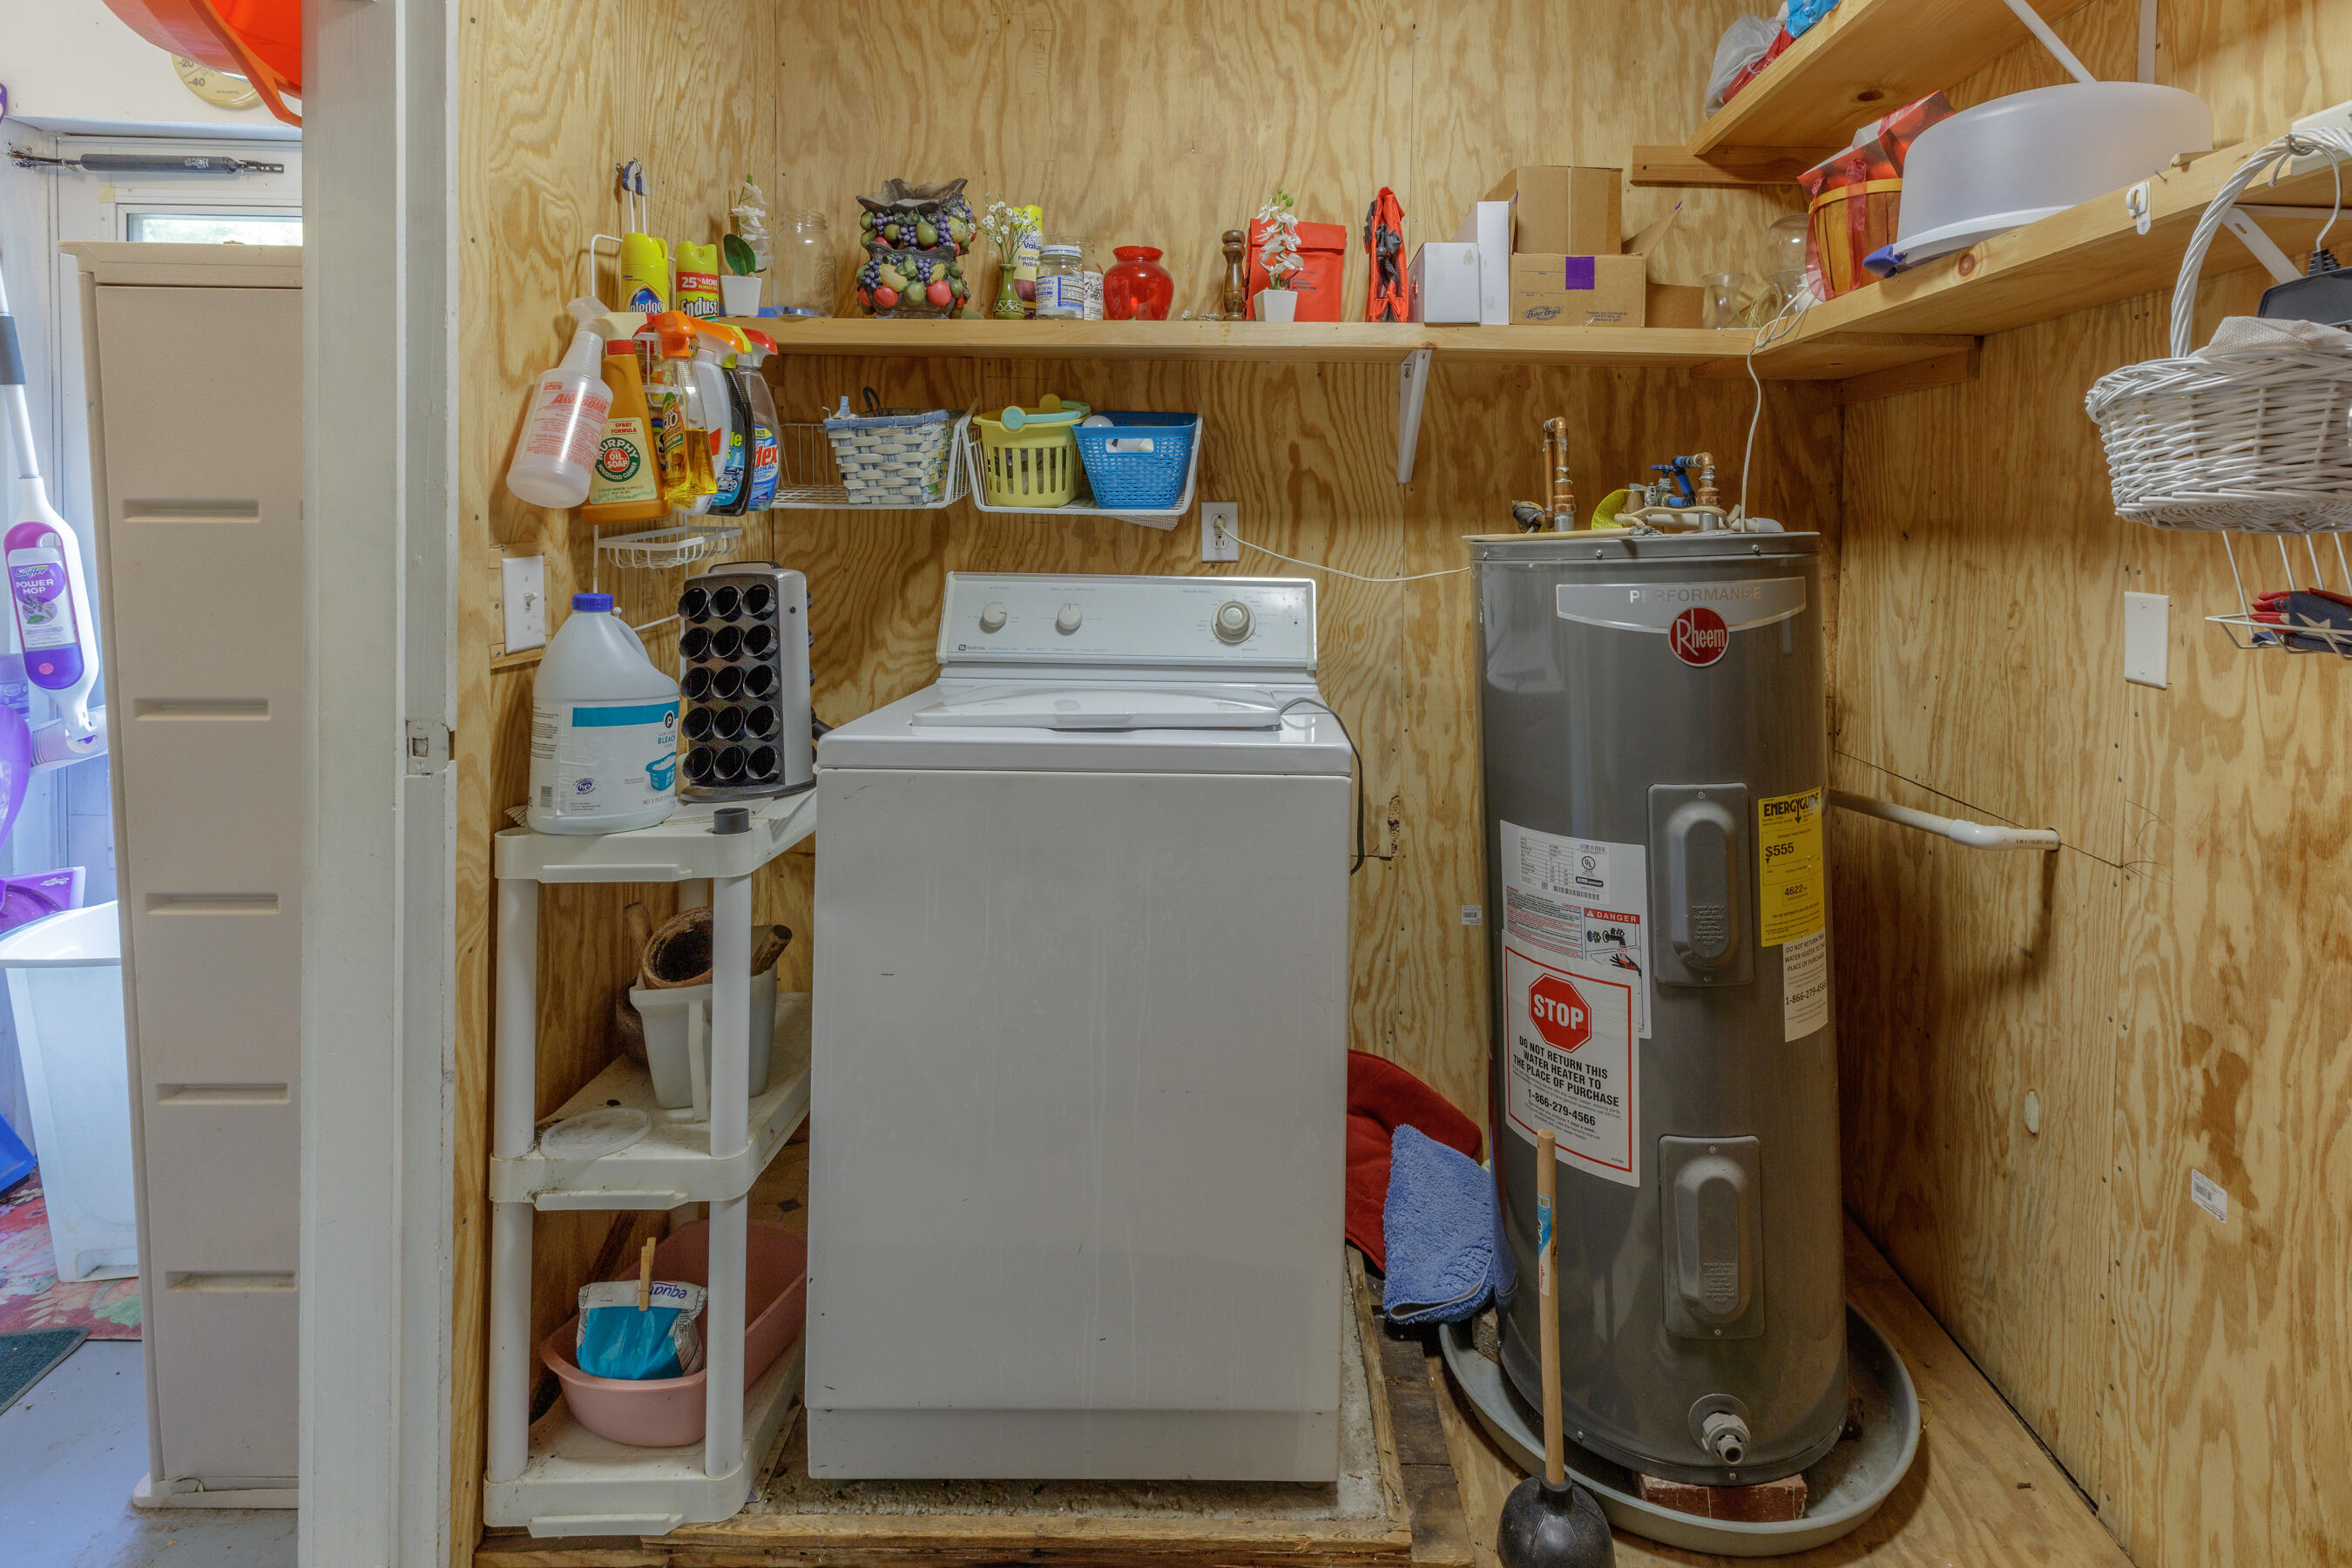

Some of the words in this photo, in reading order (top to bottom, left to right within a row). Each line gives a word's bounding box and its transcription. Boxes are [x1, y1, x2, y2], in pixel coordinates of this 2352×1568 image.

[188, 78, 206, 87] -40
[701, 278, 718, 287] MORE
[680, 297, 718, 317] Endust
[551, 393, 607, 414] AWSOME
[598, 439, 639, 460] MURPHY
[598, 464, 623, 480] HOUSEHOLD
[623, 462, 638, 478] CLEANER
[16, 578, 54, 588] POWER
[23, 586, 46, 595] MOP
[1676, 609, 1726, 656] Rheem
[1784, 884, 1803, 896] 4622
[1597, 911, 1636, 923] DANGER
[1785, 953, 1801, 963] WATER
[1801, 947, 1815, 957] HEATER
[1788, 963, 1801, 971] PLACE
[1533, 994, 1584, 1030] STOP
[1518, 1036, 1528, 1049] DO
[1530, 1042, 1545, 1057] NOT
[1547, 1049, 1582, 1072] RETURN
[1585, 1064, 1608, 1079] THIS
[1524, 1050, 1549, 1071] WATER
[1551, 1063, 1585, 1085] HEATER
[1588, 1078, 1601, 1090] TO
[1513, 1054, 1525, 1070] THE
[1526, 1063, 1551, 1084] PLACE
[1553, 1077, 1565, 1089] OF
[1567, 1082, 1619, 1107] PURCHASE
[1528, 1089, 1595, 1126] 1-866-279-4566
[648, 1285, 687, 1300] equat
